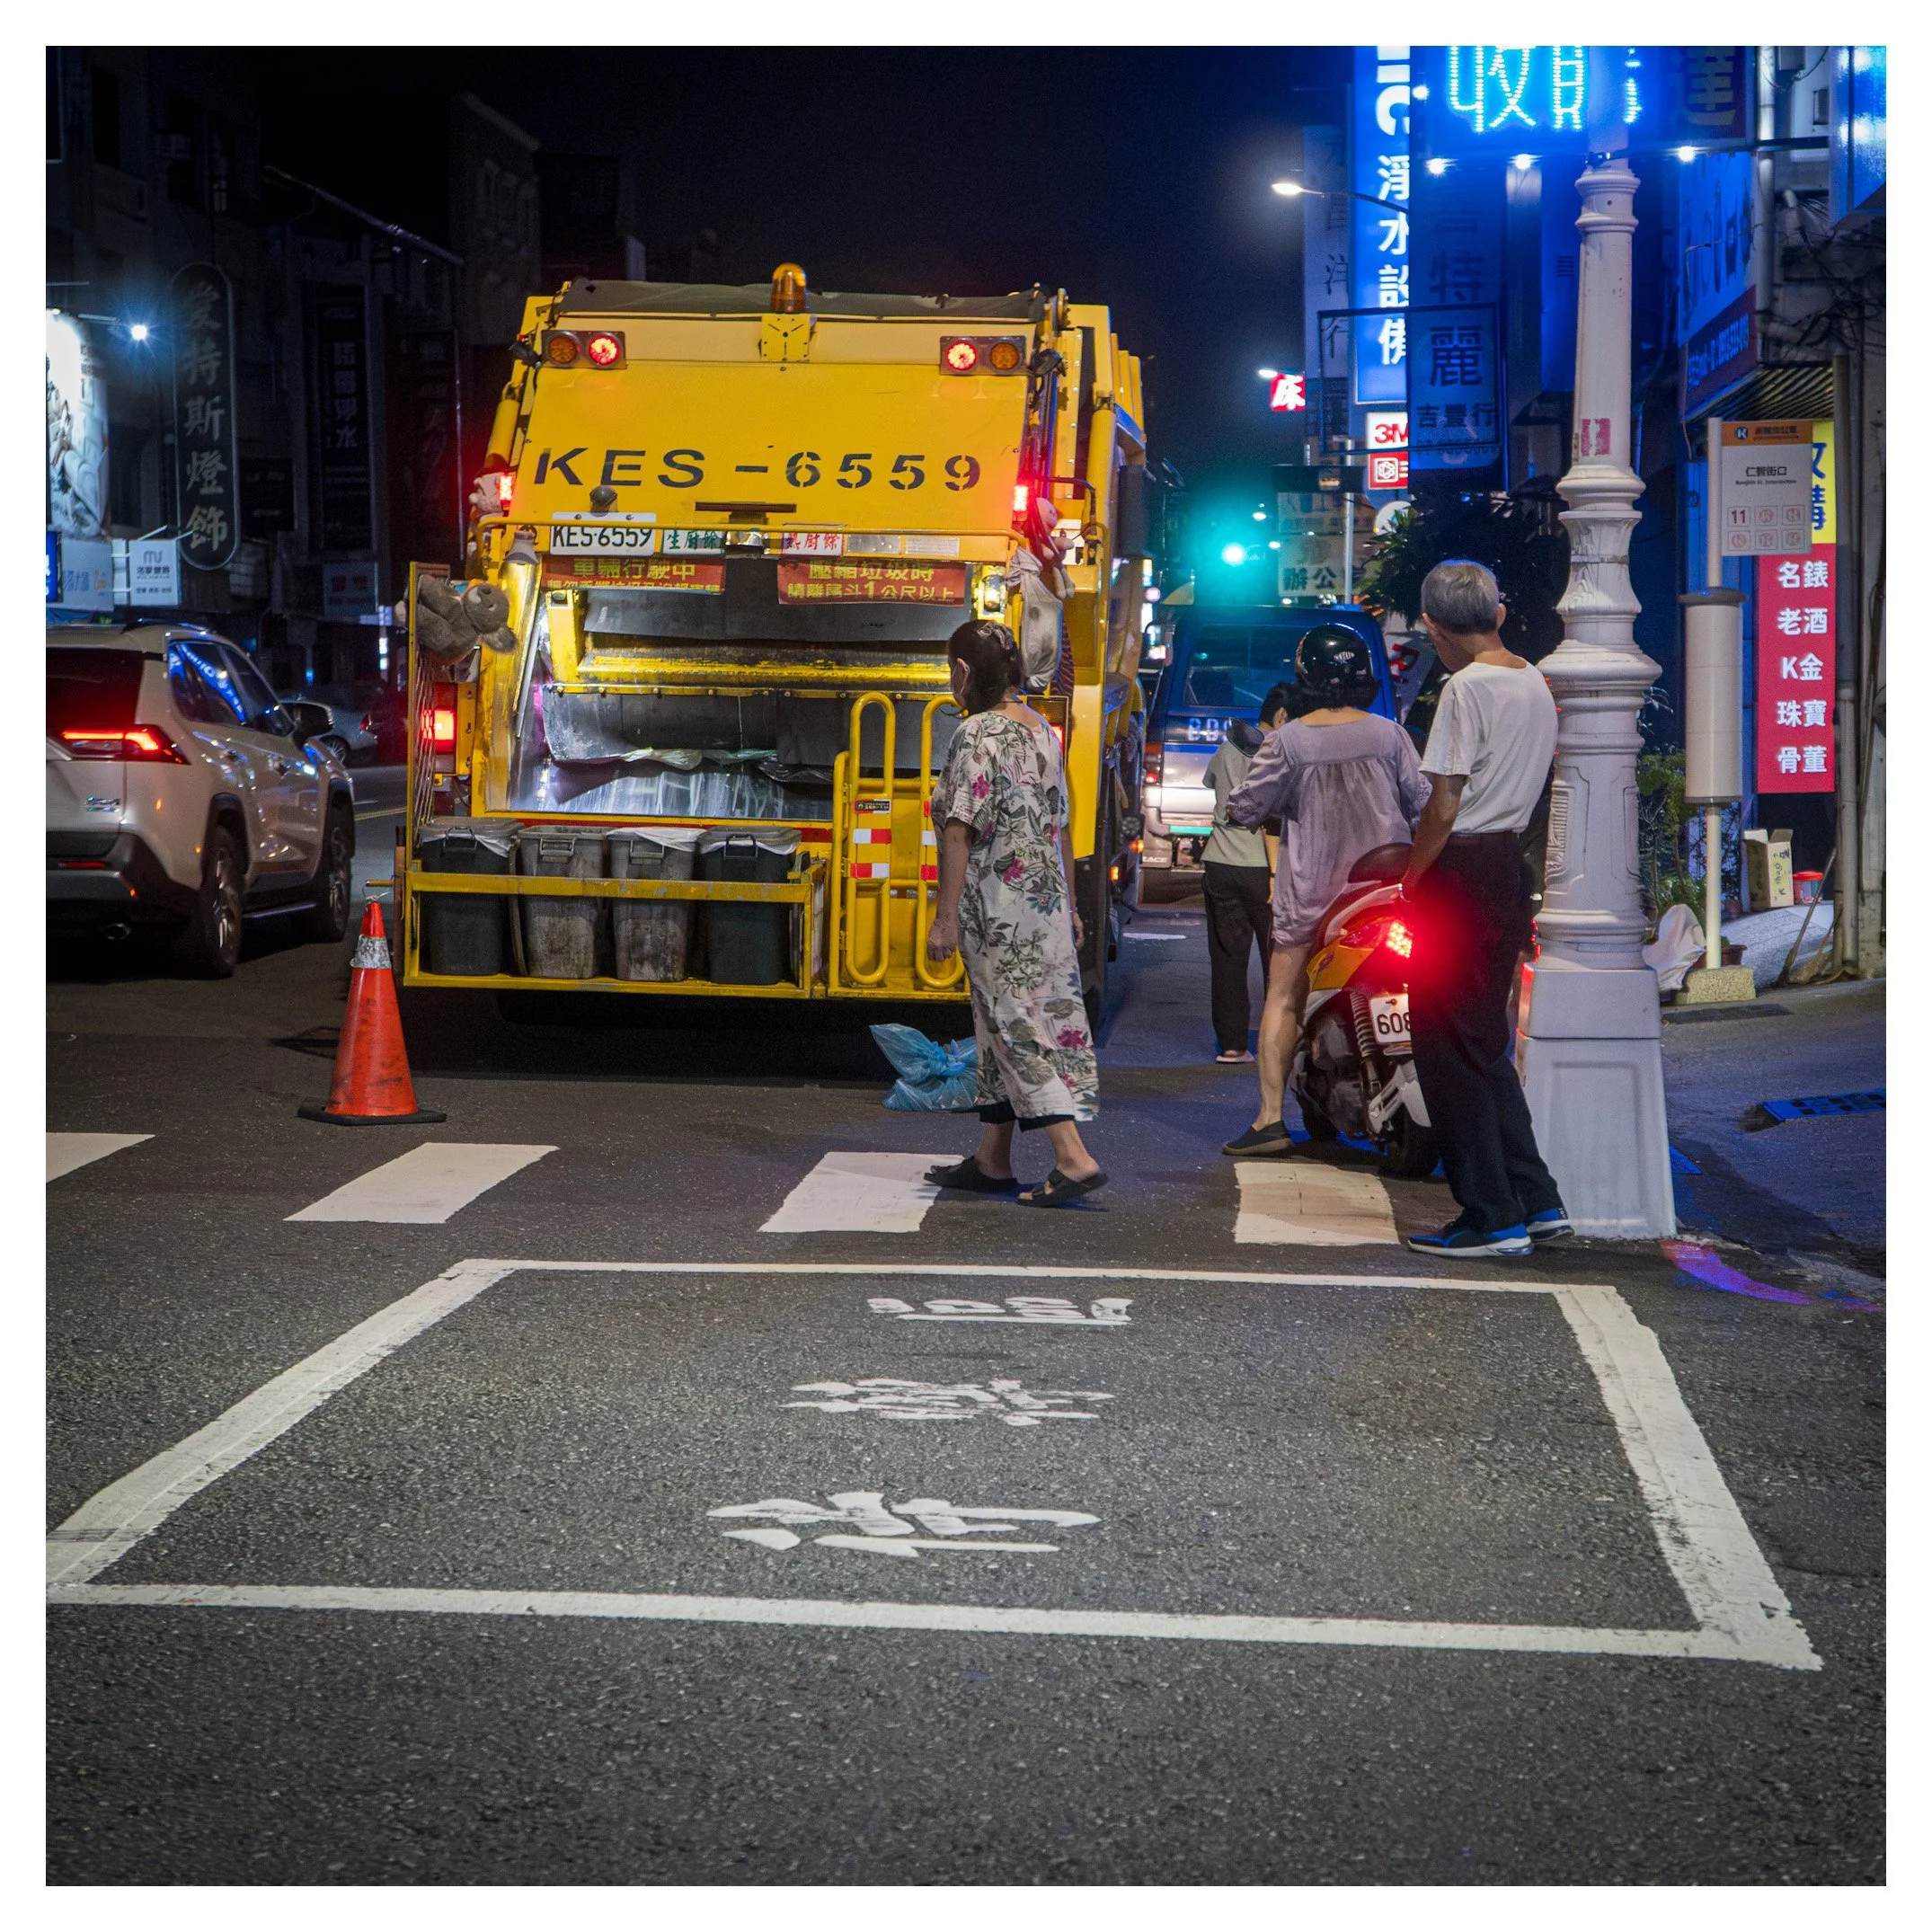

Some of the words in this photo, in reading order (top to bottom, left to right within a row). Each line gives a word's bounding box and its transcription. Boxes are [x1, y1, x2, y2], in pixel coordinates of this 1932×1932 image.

[1731, 510, 1746, 524] 11
[1777, 560, 1829, 589] 名錶
[1777, 607, 1829, 636] 老酒
[1781, 652, 1824, 681] K金
[1777, 699, 1828, 728] 珠寶
[1777, 745, 1828, 775] 骨董
